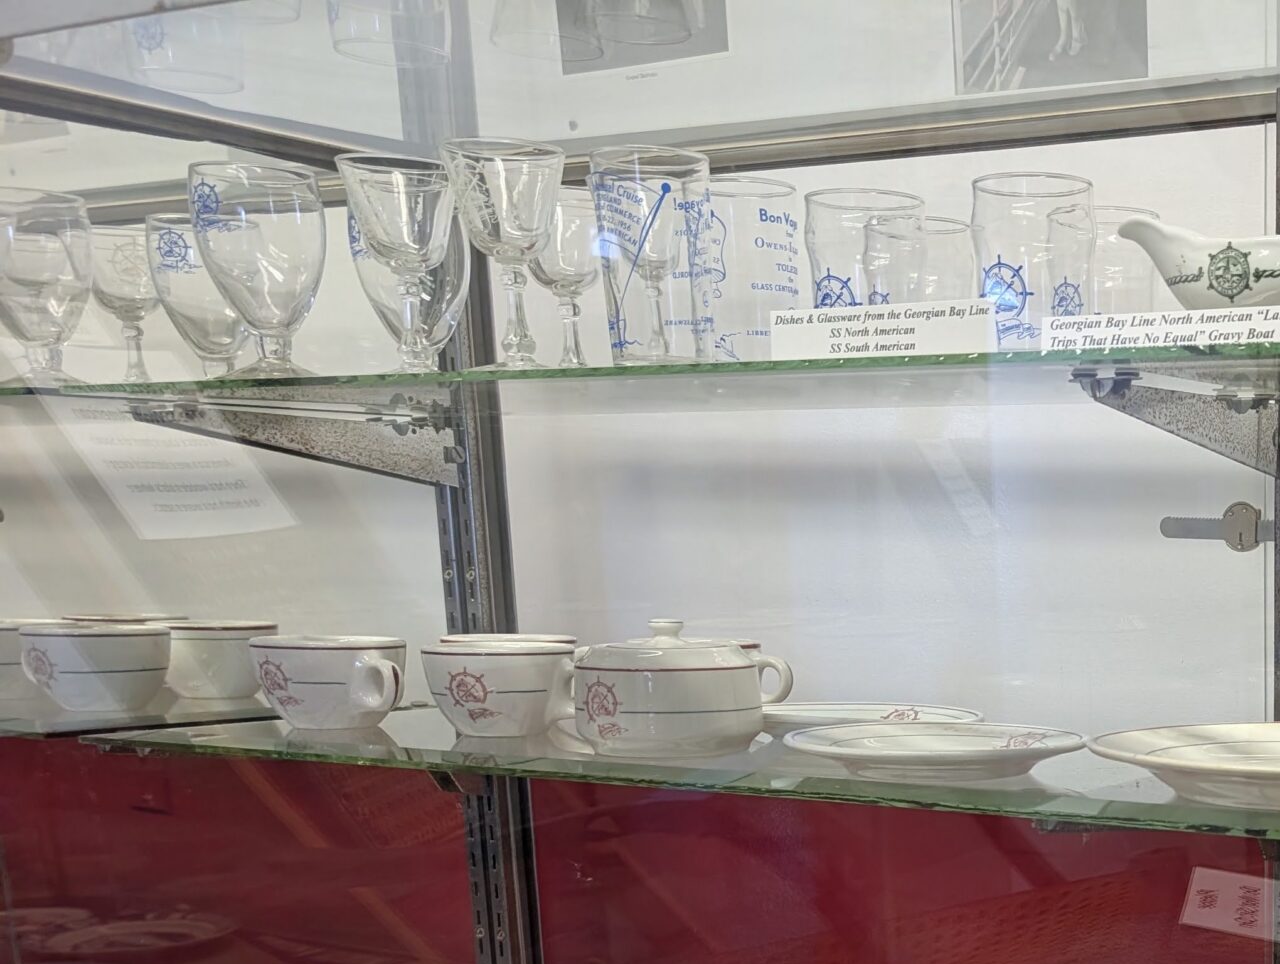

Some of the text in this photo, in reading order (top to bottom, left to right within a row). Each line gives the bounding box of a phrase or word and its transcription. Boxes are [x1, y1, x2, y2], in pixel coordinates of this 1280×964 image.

[617, 184, 644, 207] Cruise
[759, 207, 783, 225] Bon
[752, 282, 774, 292] GLASS
[774, 305, 990, 326] Dishes & Glassware from the Georgian Bay Line
[1050, 318, 1102, 333] Georgian
[1105, 317, 1127, 331] Bay
[1130, 315, 1157, 328] Line
[1159, 314, 1193, 327] North
[1195, 311, 1253, 325] American
[747, 329, 770, 337] LIBBE
[829, 325, 916, 339] SS North American
[1050, 336, 1077, 349] Trips
[1081, 334, 1108, 347] That
[1111, 333, 1140, 346] Have
[1142, 332, 1160, 345] No
[1208, 328, 1244, 343] Gravy
[1246, 327, 1275, 340] Boat
[829, 340, 916, 354] SS South American
